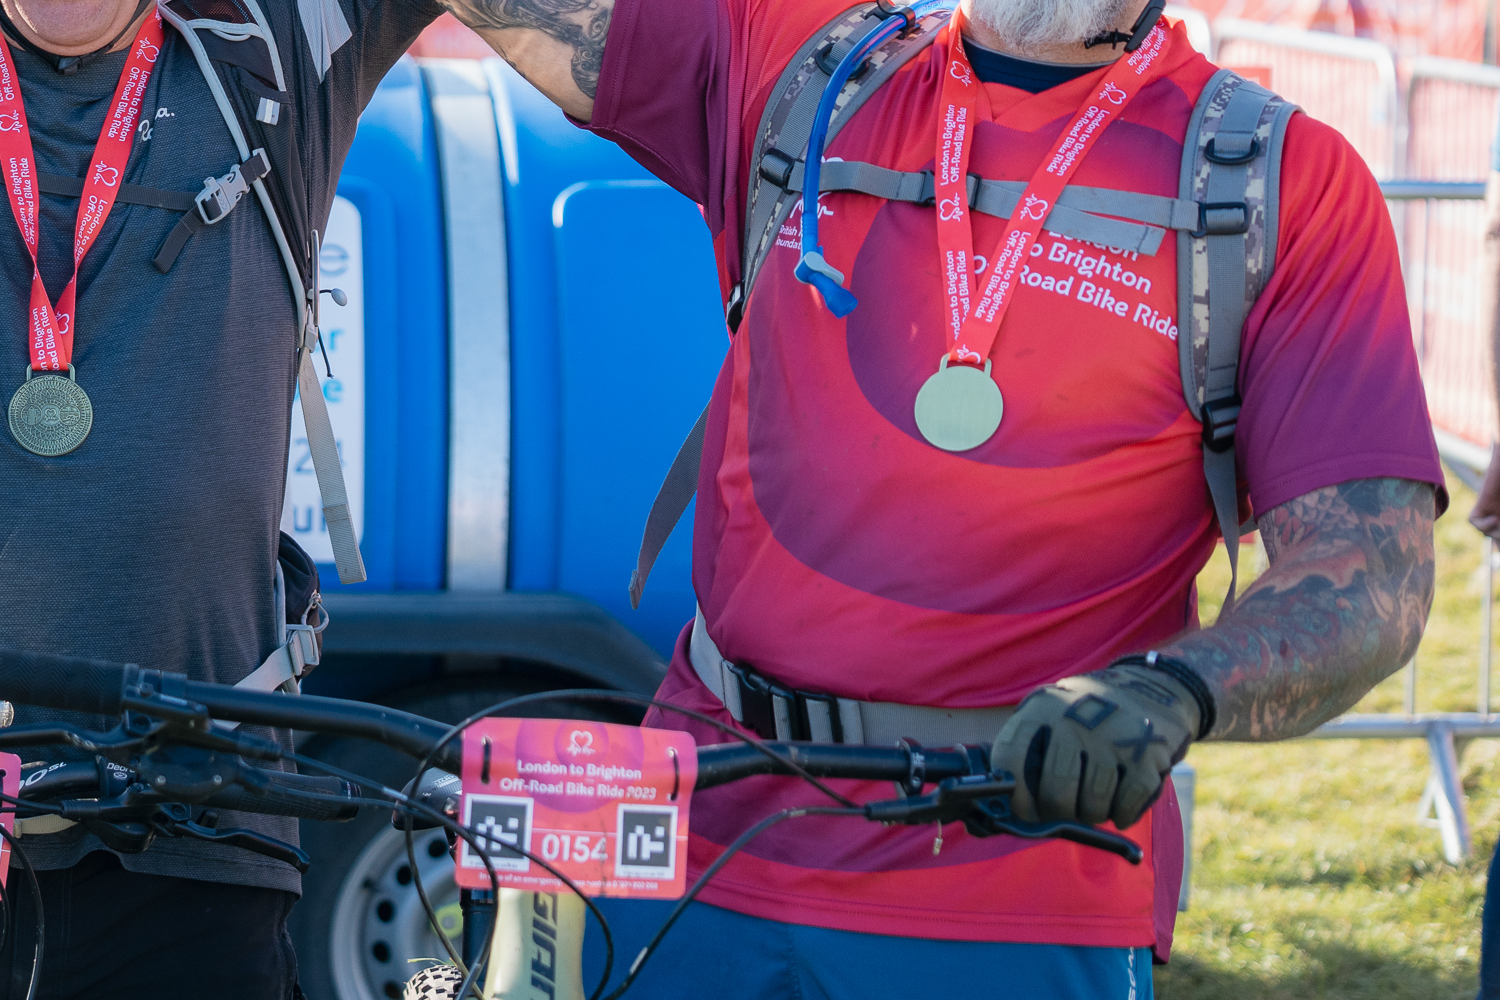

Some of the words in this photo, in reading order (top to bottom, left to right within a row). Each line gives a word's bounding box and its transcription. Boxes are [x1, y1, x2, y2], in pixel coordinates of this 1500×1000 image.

[120, 66, 140, 101] Off-Road
[134, 70, 152, 97] London
[114, 101, 128, 119] Bike
[131, 97, 142, 107] to
[956, 106, 967, 122] Ride
[108, 119, 122, 138] Ride
[118, 107, 138, 142] Brighton
[942, 104, 956, 140] Brighton
[954, 124, 966, 141] Bike
[1069, 106, 1099, 138] Off-Road
[1084, 109, 1111, 134] London
[942, 140, 952, 150] to
[1058, 136, 1076, 154] Bike
[1078, 134, 1090, 142] to
[19, 158, 30, 178] Ride
[940, 150, 950, 186] London
[950, 141, 963, 183] Off-Road
[1046, 153, 1064, 173] Ride
[1056, 142, 1085, 176] Brighton
[10, 158, 22, 196] Brighton
[22, 179, 34, 199] Bike
[18, 196, 25, 206] to
[26, 200, 35, 245] Off-Road
[78, 195, 98, 239] Off-Road
[86, 199, 108, 234] London
[82, 236, 90, 246] to
[994, 230, 1020, 275] Off-Road
[1008, 231, 1032, 269] London
[946, 250, 958, 296] Brighton
[956, 250, 966, 272] Ride
[1047, 241, 1153, 295] Brighton
[958, 272, 969, 298] Bike
[984, 274, 1001, 297] Bike
[1004, 269, 1014, 280] to
[950, 295, 958, 308] to
[974, 296, 992, 319] Ride
[985, 280, 1010, 323] Brighton
[1076, 280, 1130, 319] Bike
[1132, 301, 1179, 341] Ride
[32, 307, 45, 349] Brighton
[40, 304, 50, 328] Ride
[46, 328, 56, 350] Bike
[38, 350, 46, 360] to
[516, 759, 568, 775] London
[569, 763, 584, 776] to
[586, 764, 642, 781] Brighton
[500, 777, 564, 795] Off-Road
[566, 782, 595, 796] Bike
[597, 784, 624, 798] Ride
[626, 786, 657, 800] 2023
[542, 833, 609, 863] 0154
